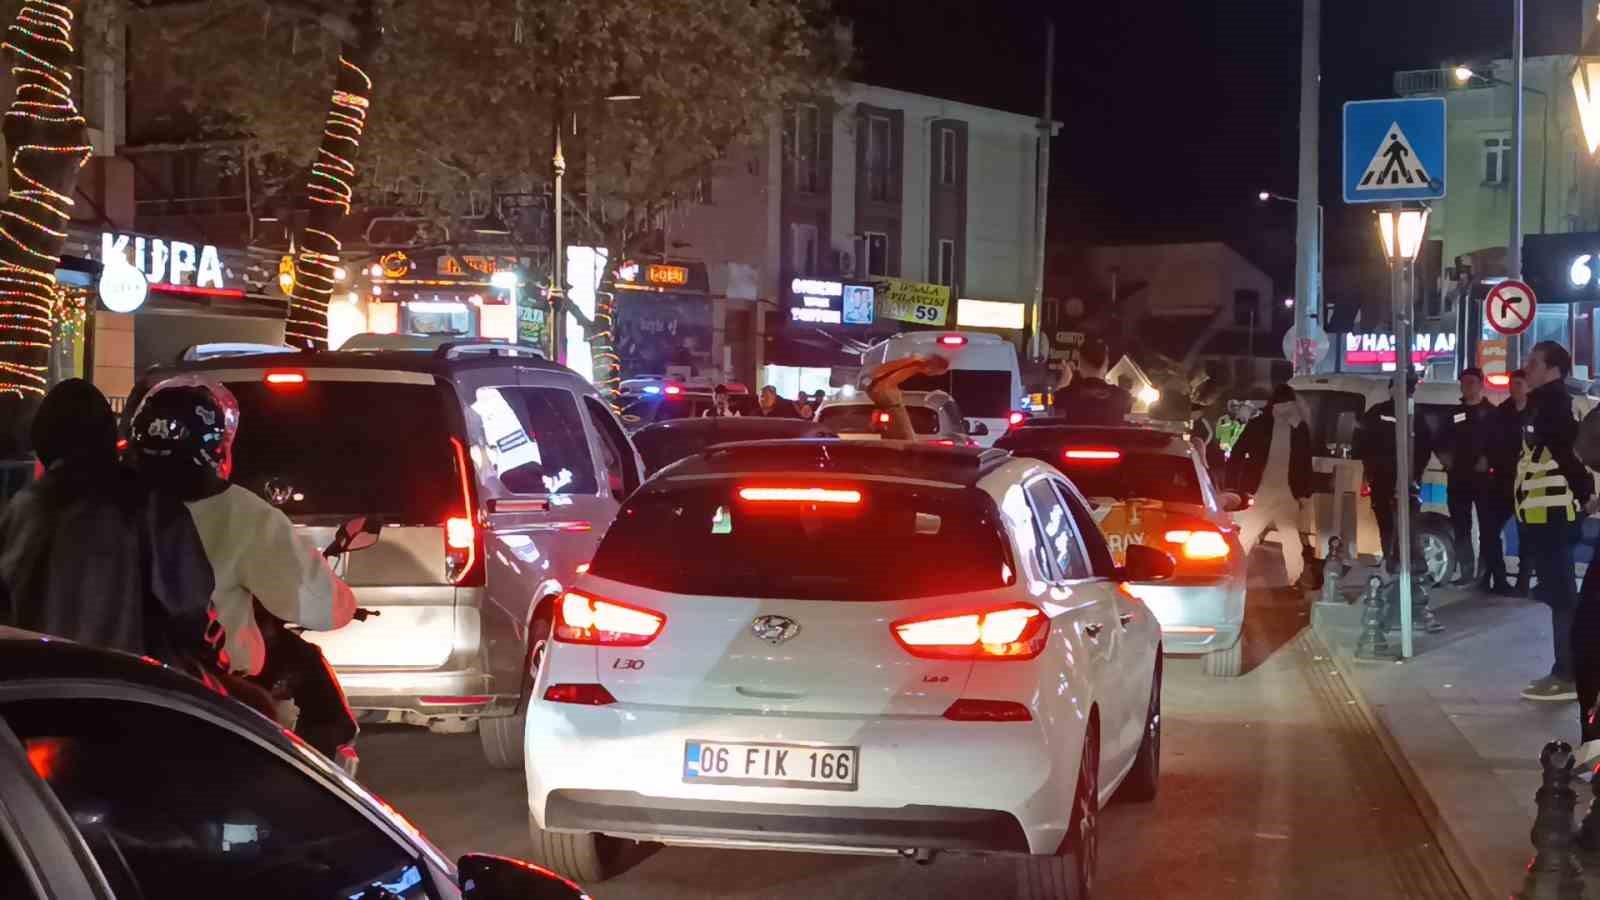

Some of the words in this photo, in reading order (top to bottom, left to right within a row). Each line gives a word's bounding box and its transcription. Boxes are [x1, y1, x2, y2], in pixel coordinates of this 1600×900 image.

[102, 232, 224, 288] KUPA
[915, 304, 938, 321] 59
[1362, 333, 1431, 352] HASN
[700, 746, 730, 774] 06
[744, 748, 790, 777] FIK
[808, 751, 851, 781] 166
